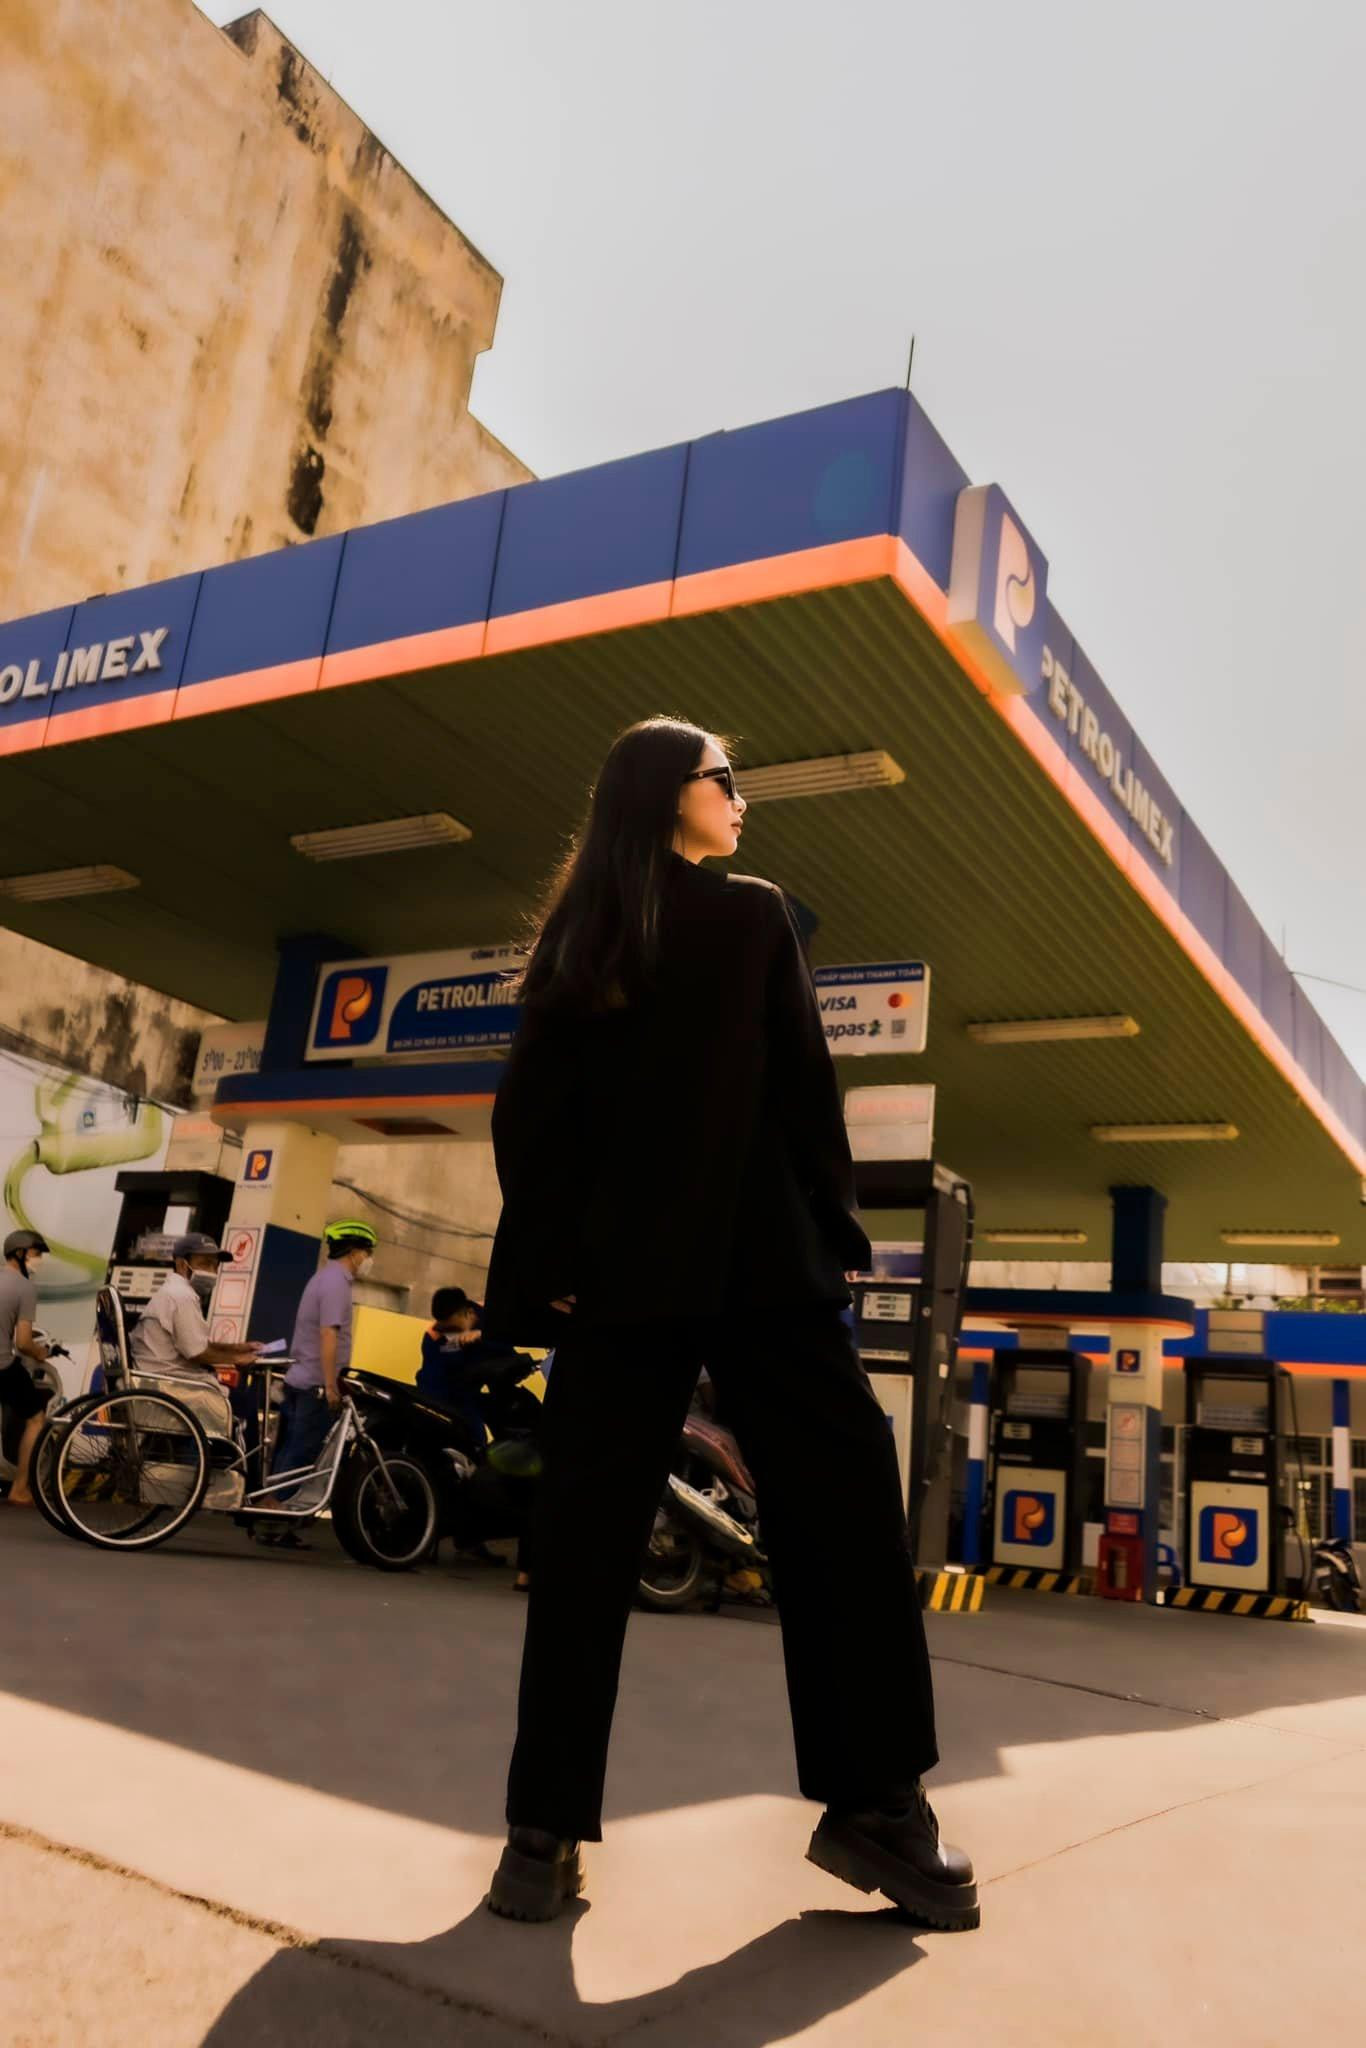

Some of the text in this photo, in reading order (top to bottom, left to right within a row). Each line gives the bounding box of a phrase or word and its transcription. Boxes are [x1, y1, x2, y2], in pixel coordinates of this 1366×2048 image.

[416, 982, 523, 1012] PETROLIME
[820, 996, 857, 1011] VISA
[825, 1023, 865, 1041] apas
